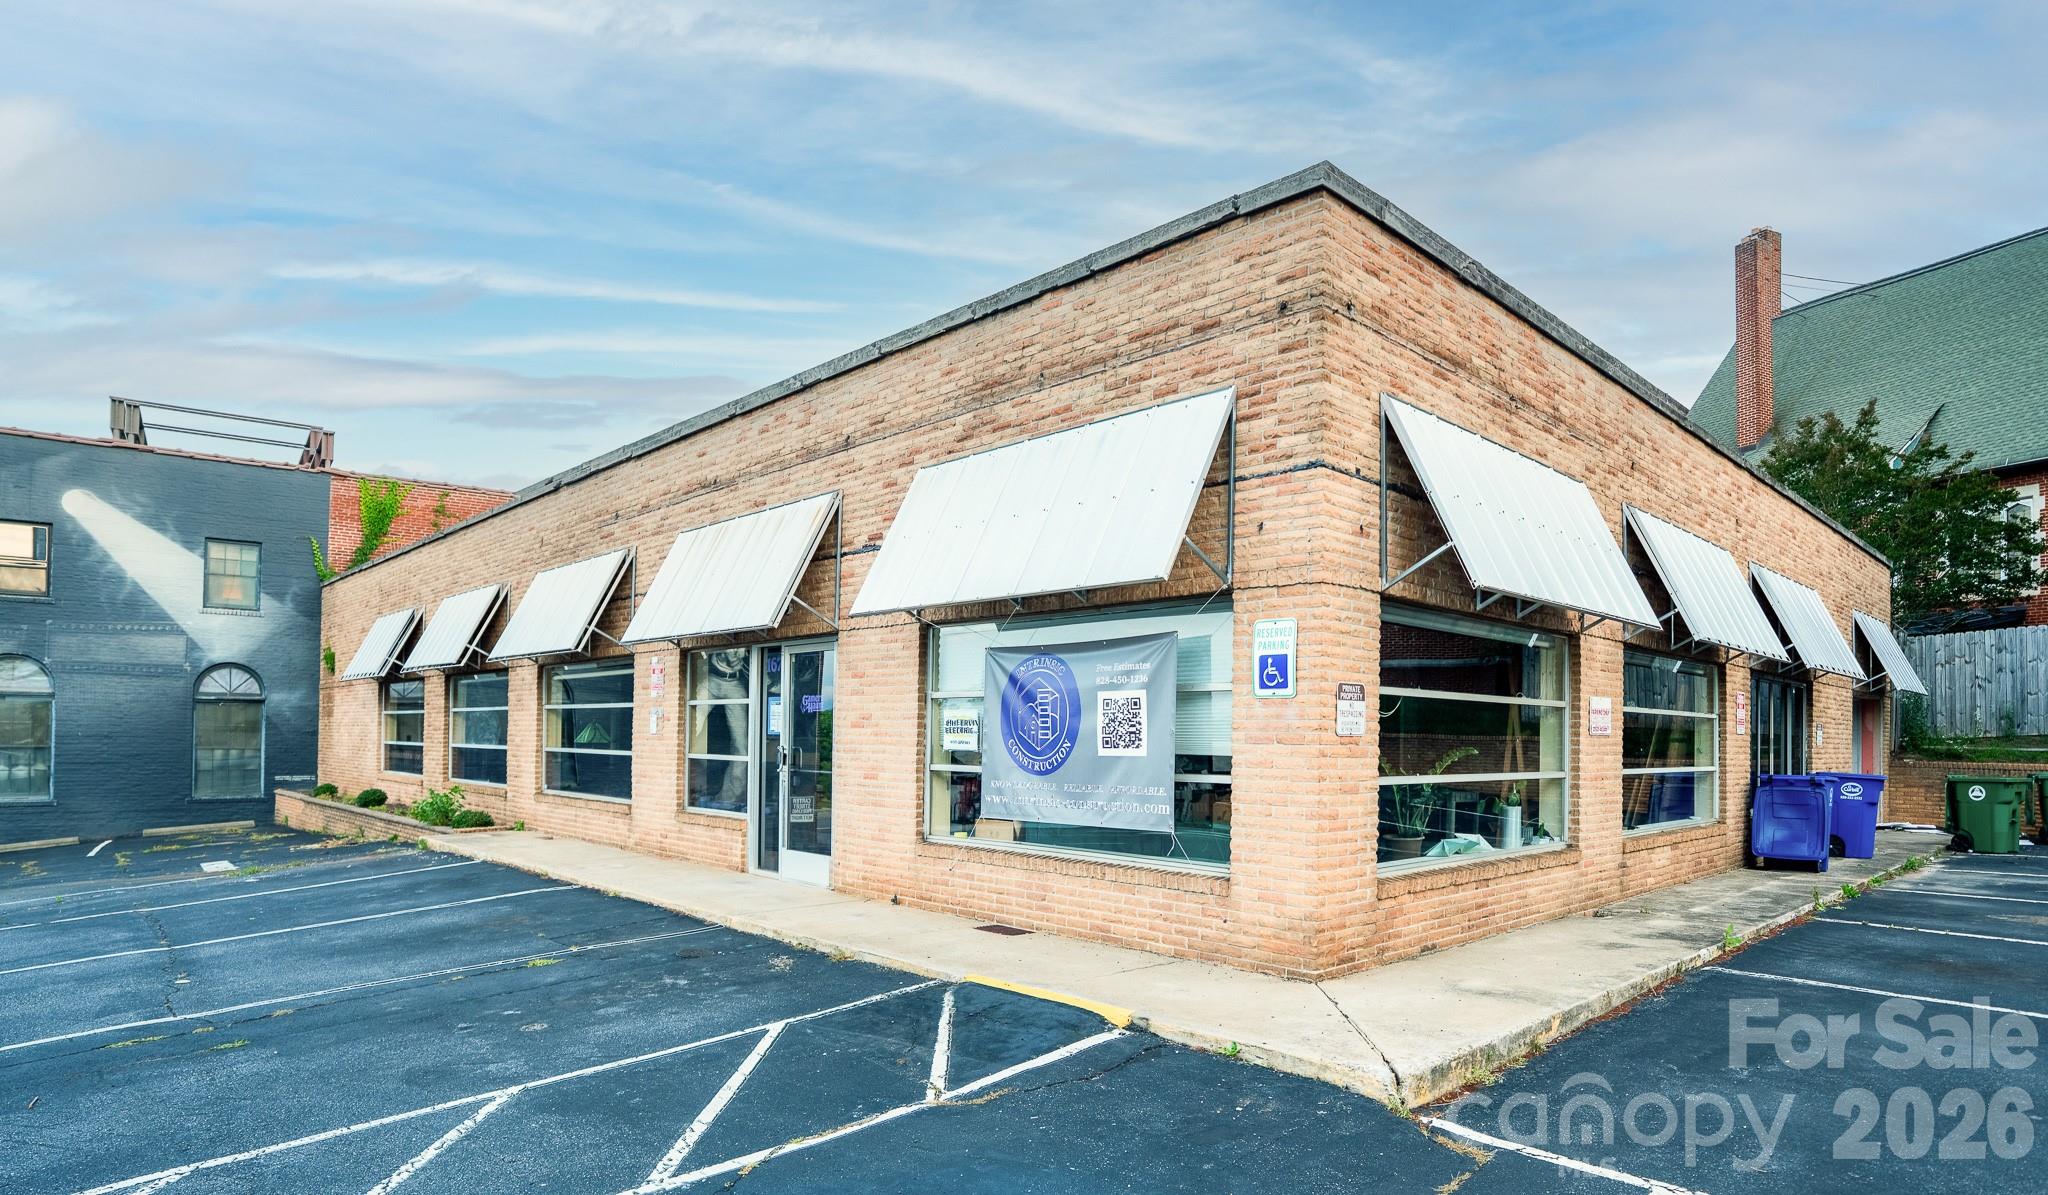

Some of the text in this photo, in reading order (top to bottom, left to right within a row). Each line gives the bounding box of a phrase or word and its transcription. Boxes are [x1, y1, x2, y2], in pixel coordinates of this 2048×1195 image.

[1257, 627, 1293, 638] RESERVED
[1258, 639, 1290, 650] PARKING
[1016, 658, 1066, 677] INTRINSIC
[1096, 660, 1152, 672] Free Estimates
[1342, 685, 1361, 693] PRIVATE
[1340, 692, 1363, 700] PROPERTY
[1008, 739, 1072, 772] CONSTRUCTION
